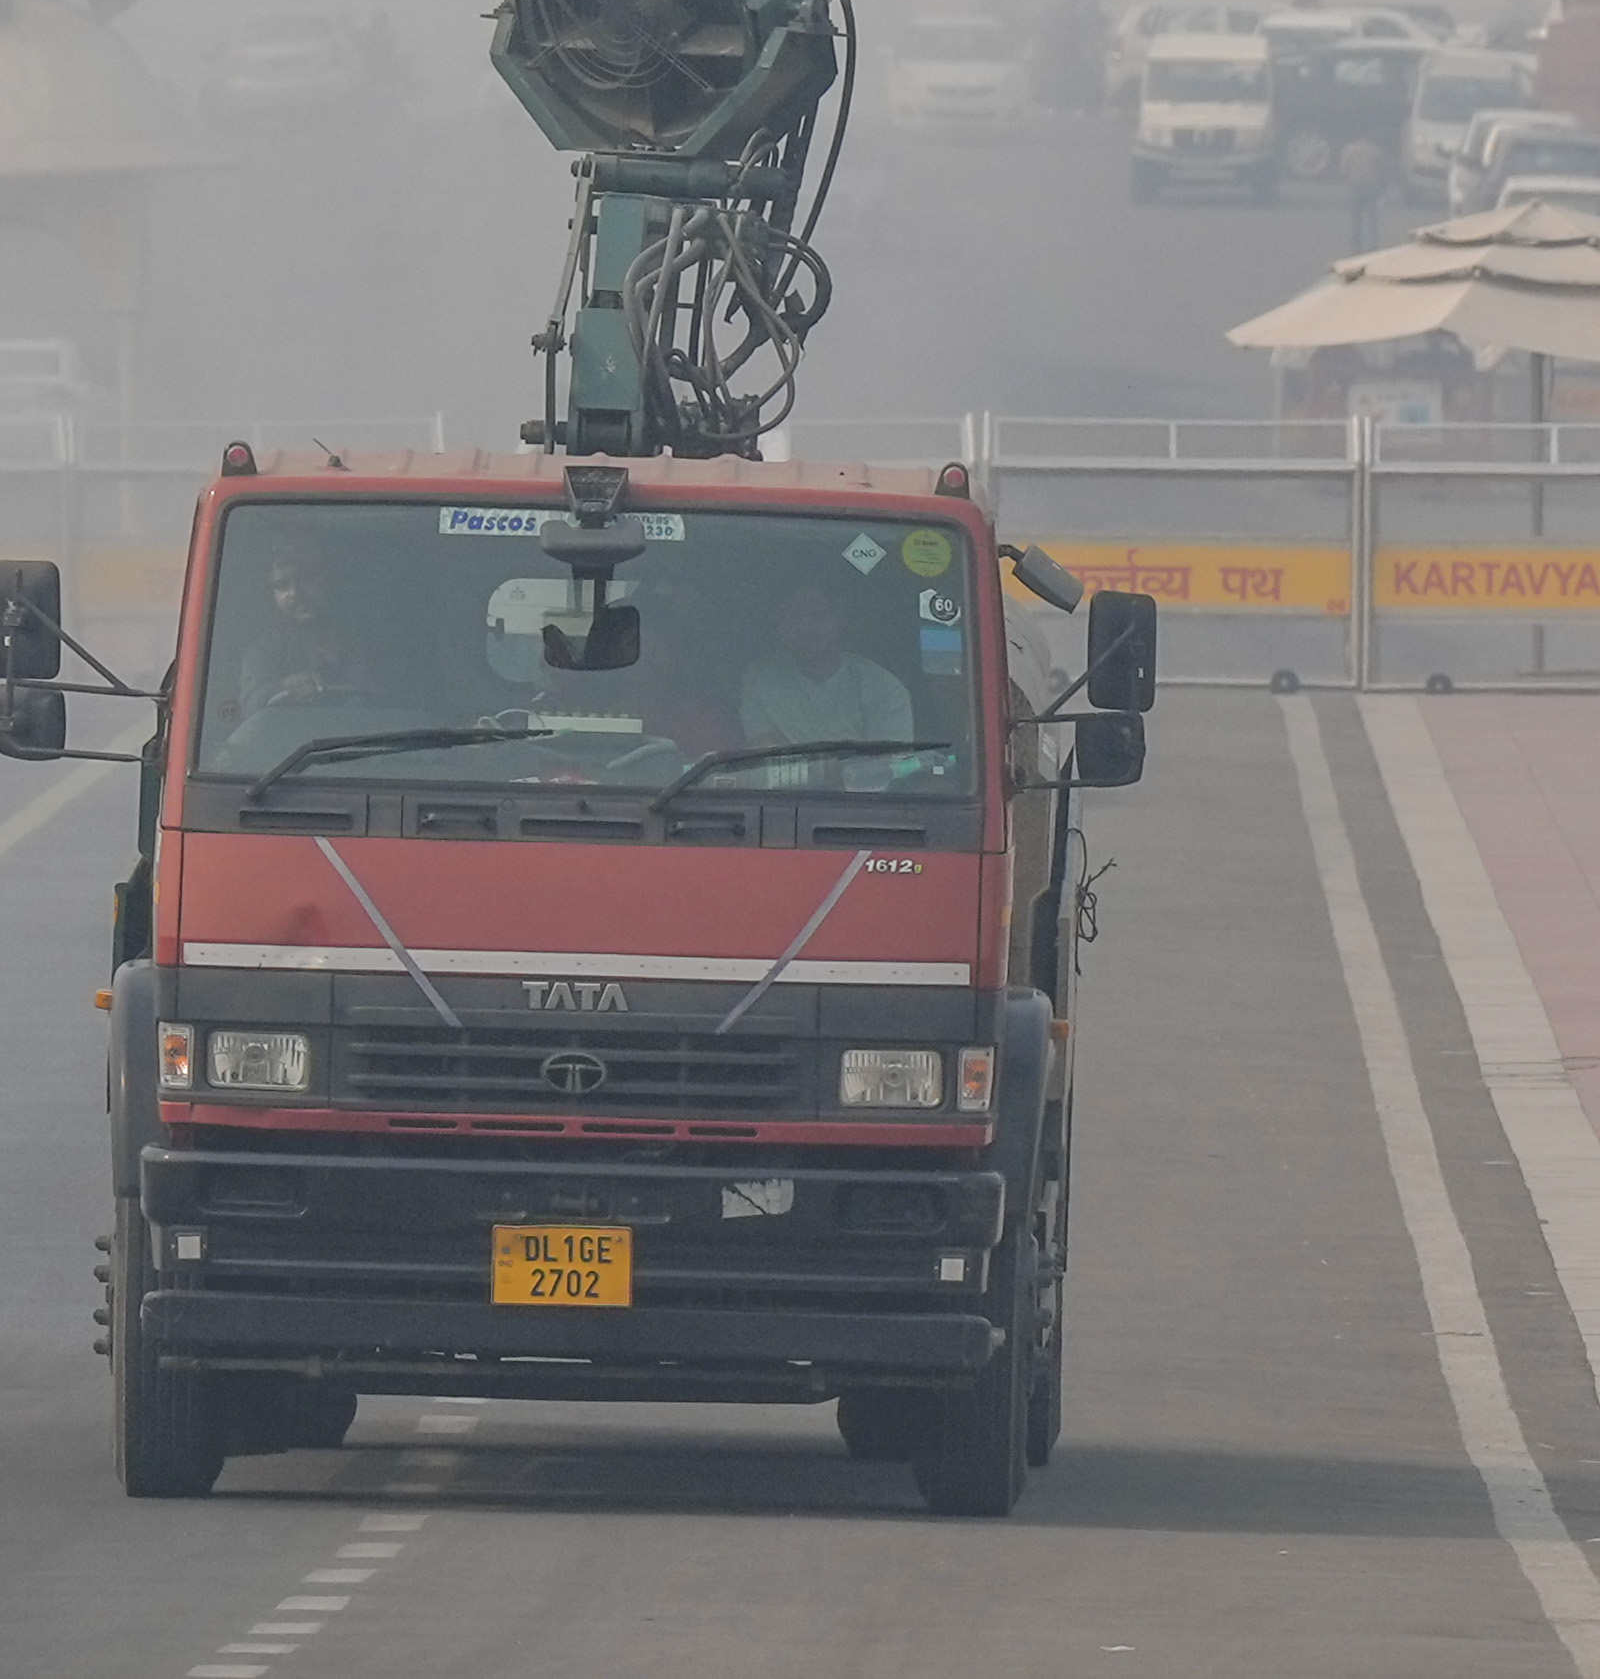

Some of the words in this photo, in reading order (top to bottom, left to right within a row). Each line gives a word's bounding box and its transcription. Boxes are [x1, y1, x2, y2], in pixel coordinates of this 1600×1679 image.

[448, 509, 537, 532] Pascos
[851, 548, 878, 559] CNG
[1220, 567, 1284, 601] पथ
[934, 598, 954, 612] 60
[521, 980, 630, 1011] TATA
[530, 1268, 600, 1299] 2702
